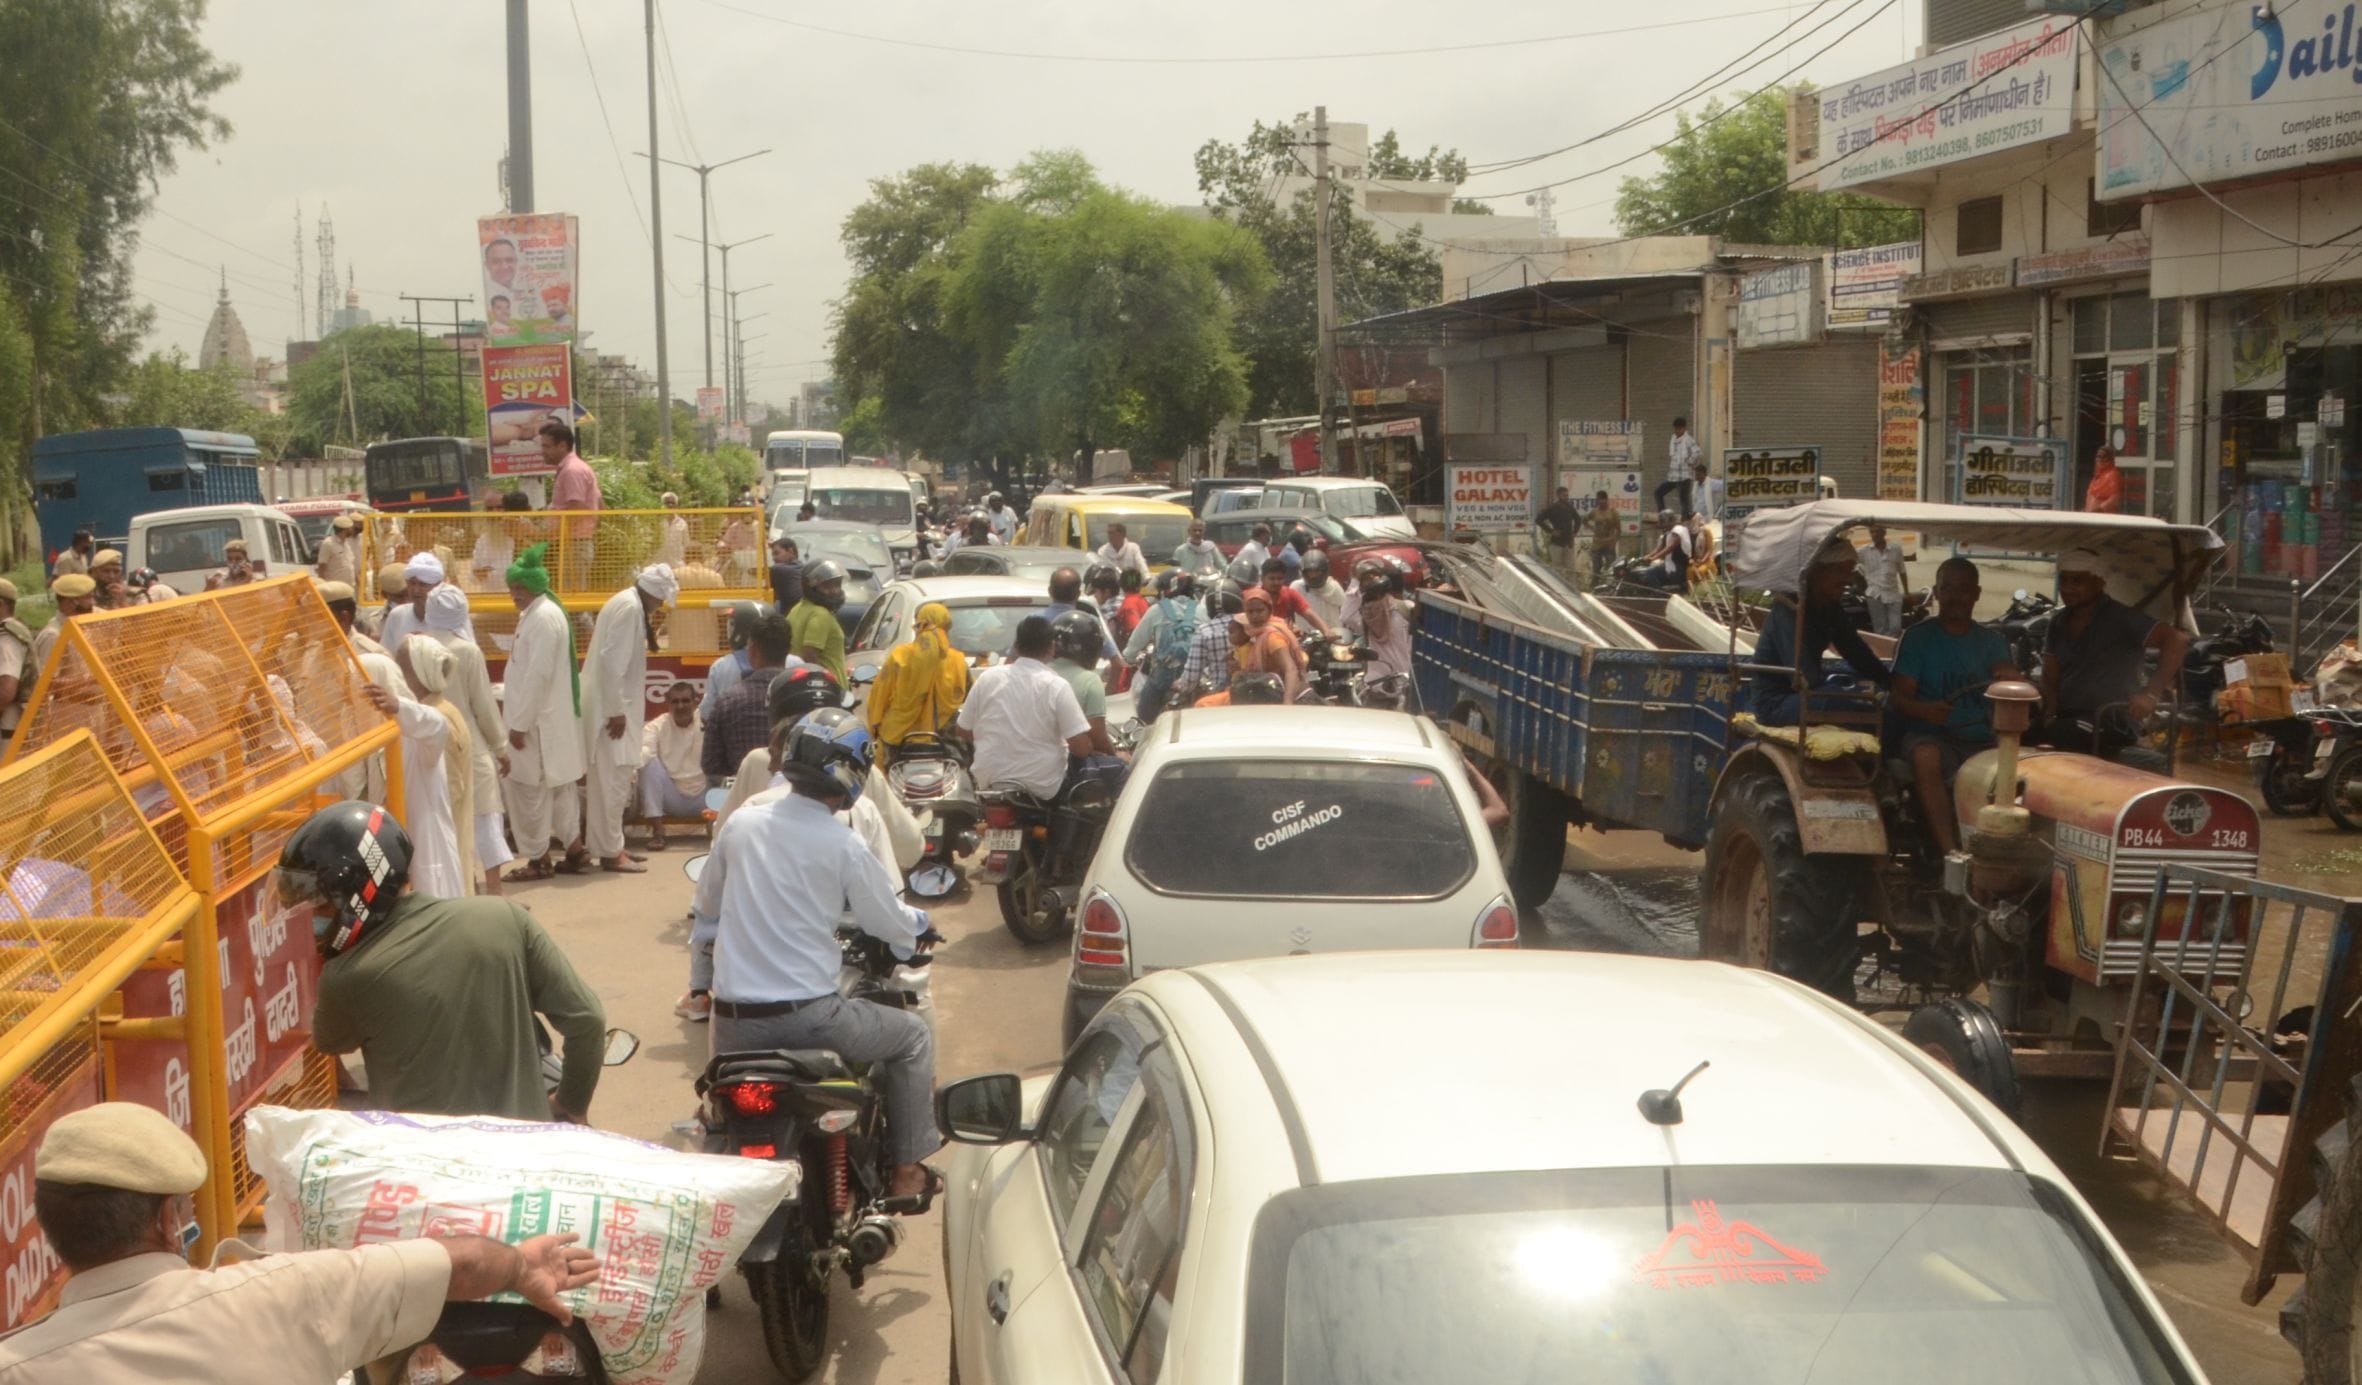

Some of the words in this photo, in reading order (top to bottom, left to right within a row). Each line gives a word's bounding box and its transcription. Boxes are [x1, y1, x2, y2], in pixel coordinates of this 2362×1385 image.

[1823, 99, 1837, 122] यह
[1887, 68, 1916, 102] अपने
[1919, 69, 1938, 94] नए
[1941, 58, 1968, 86] नाम
[1836, 127, 1848, 154] के
[1850, 130, 1872, 151] साथ
[1939, 103, 1956, 128] पर
[1958, 77, 2030, 125] निर्माणाधीन
[2282, 115, 2332, 136] Complete
[1841, 159, 1879, 181] Contact
[1975, 118, 2044, 150] 8607507531
[2255, 142, 2297, 163] Contact
[1831, 252, 1870, 270] SCIENCE
[1760, 268, 1791, 297] FITNESS
[1792, 265, 1810, 291] LAB
[490, 364, 563, 381] JANNAT
[501, 381, 558, 401] SPA
[1561, 421, 1581, 434] THE
[1583, 421, 1622, 434] FITNESS
[1623, 421, 1643, 434] LAB
[1457, 470, 1524, 484] HOTEL
[1727, 477, 1800, 498] हॉस्पिटल
[1965, 474, 2031, 496] हॉस्पिटल
[2033, 478, 2055, 496] एवं
[1455, 488, 1530, 502] GALAXY
[1456, 504, 1476, 513] VEG
[1487, 504, 1505, 513] NON
[1507, 503, 1526, 513] VEG
[1474, 513, 1492, 522] NON
[1494, 512, 1504, 522] AC
[1272, 800, 1306, 824] CISF
[1254, 805, 1342, 851] COMMANDO
[2211, 829, 2248, 848] 1348
[265, 960, 300, 1043] दादरी
[710, 1200, 737, 1239] खल
